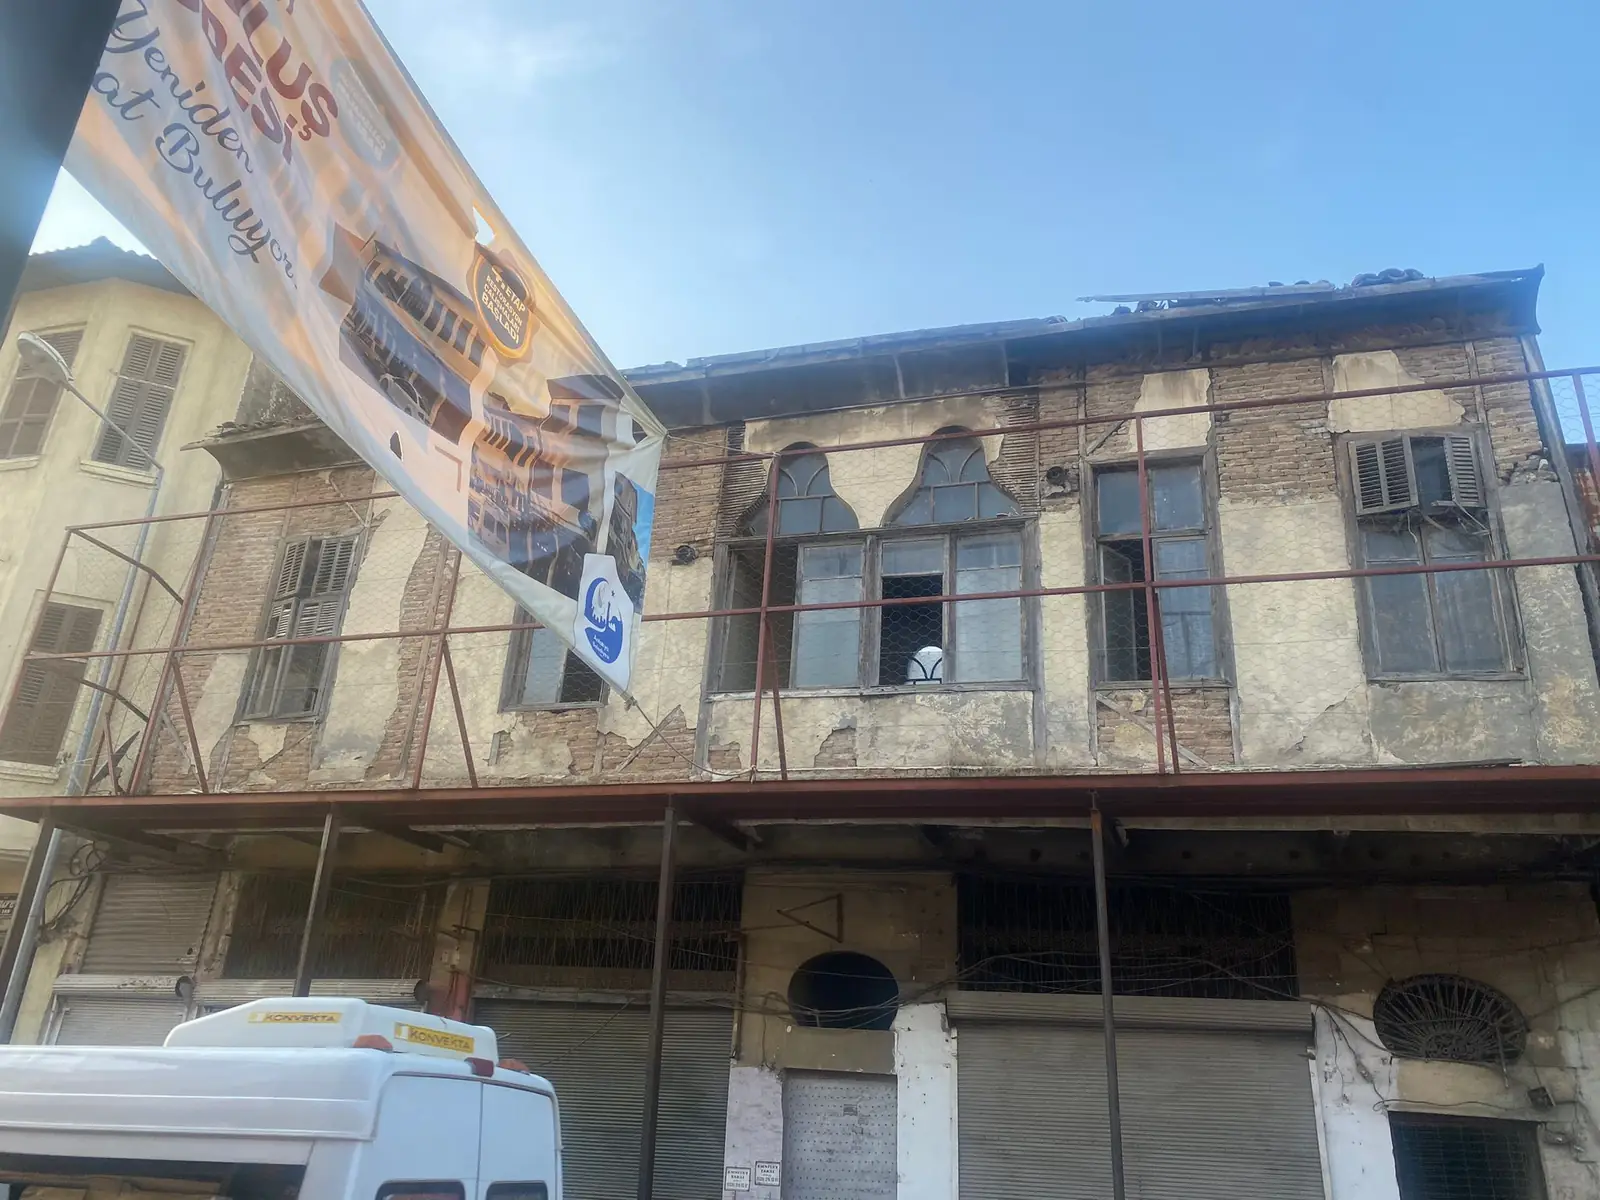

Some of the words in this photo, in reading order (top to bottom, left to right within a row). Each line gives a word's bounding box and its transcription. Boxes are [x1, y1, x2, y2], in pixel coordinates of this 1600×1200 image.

[92, 72, 161, 120] at
[105, 0, 253, 173] Yeniden
[175, 0, 298, 165] DESİ
[225, 0, 338, 141] LUŞ
[482, 292, 519, 344] BAŞLADI
[486, 275, 522, 326] RESTORASYON
[505, 285, 526, 312] ETAP
[265, 1014, 335, 1023] KONVEKTA
[410, 1031, 472, 1050] KONVEKTA
